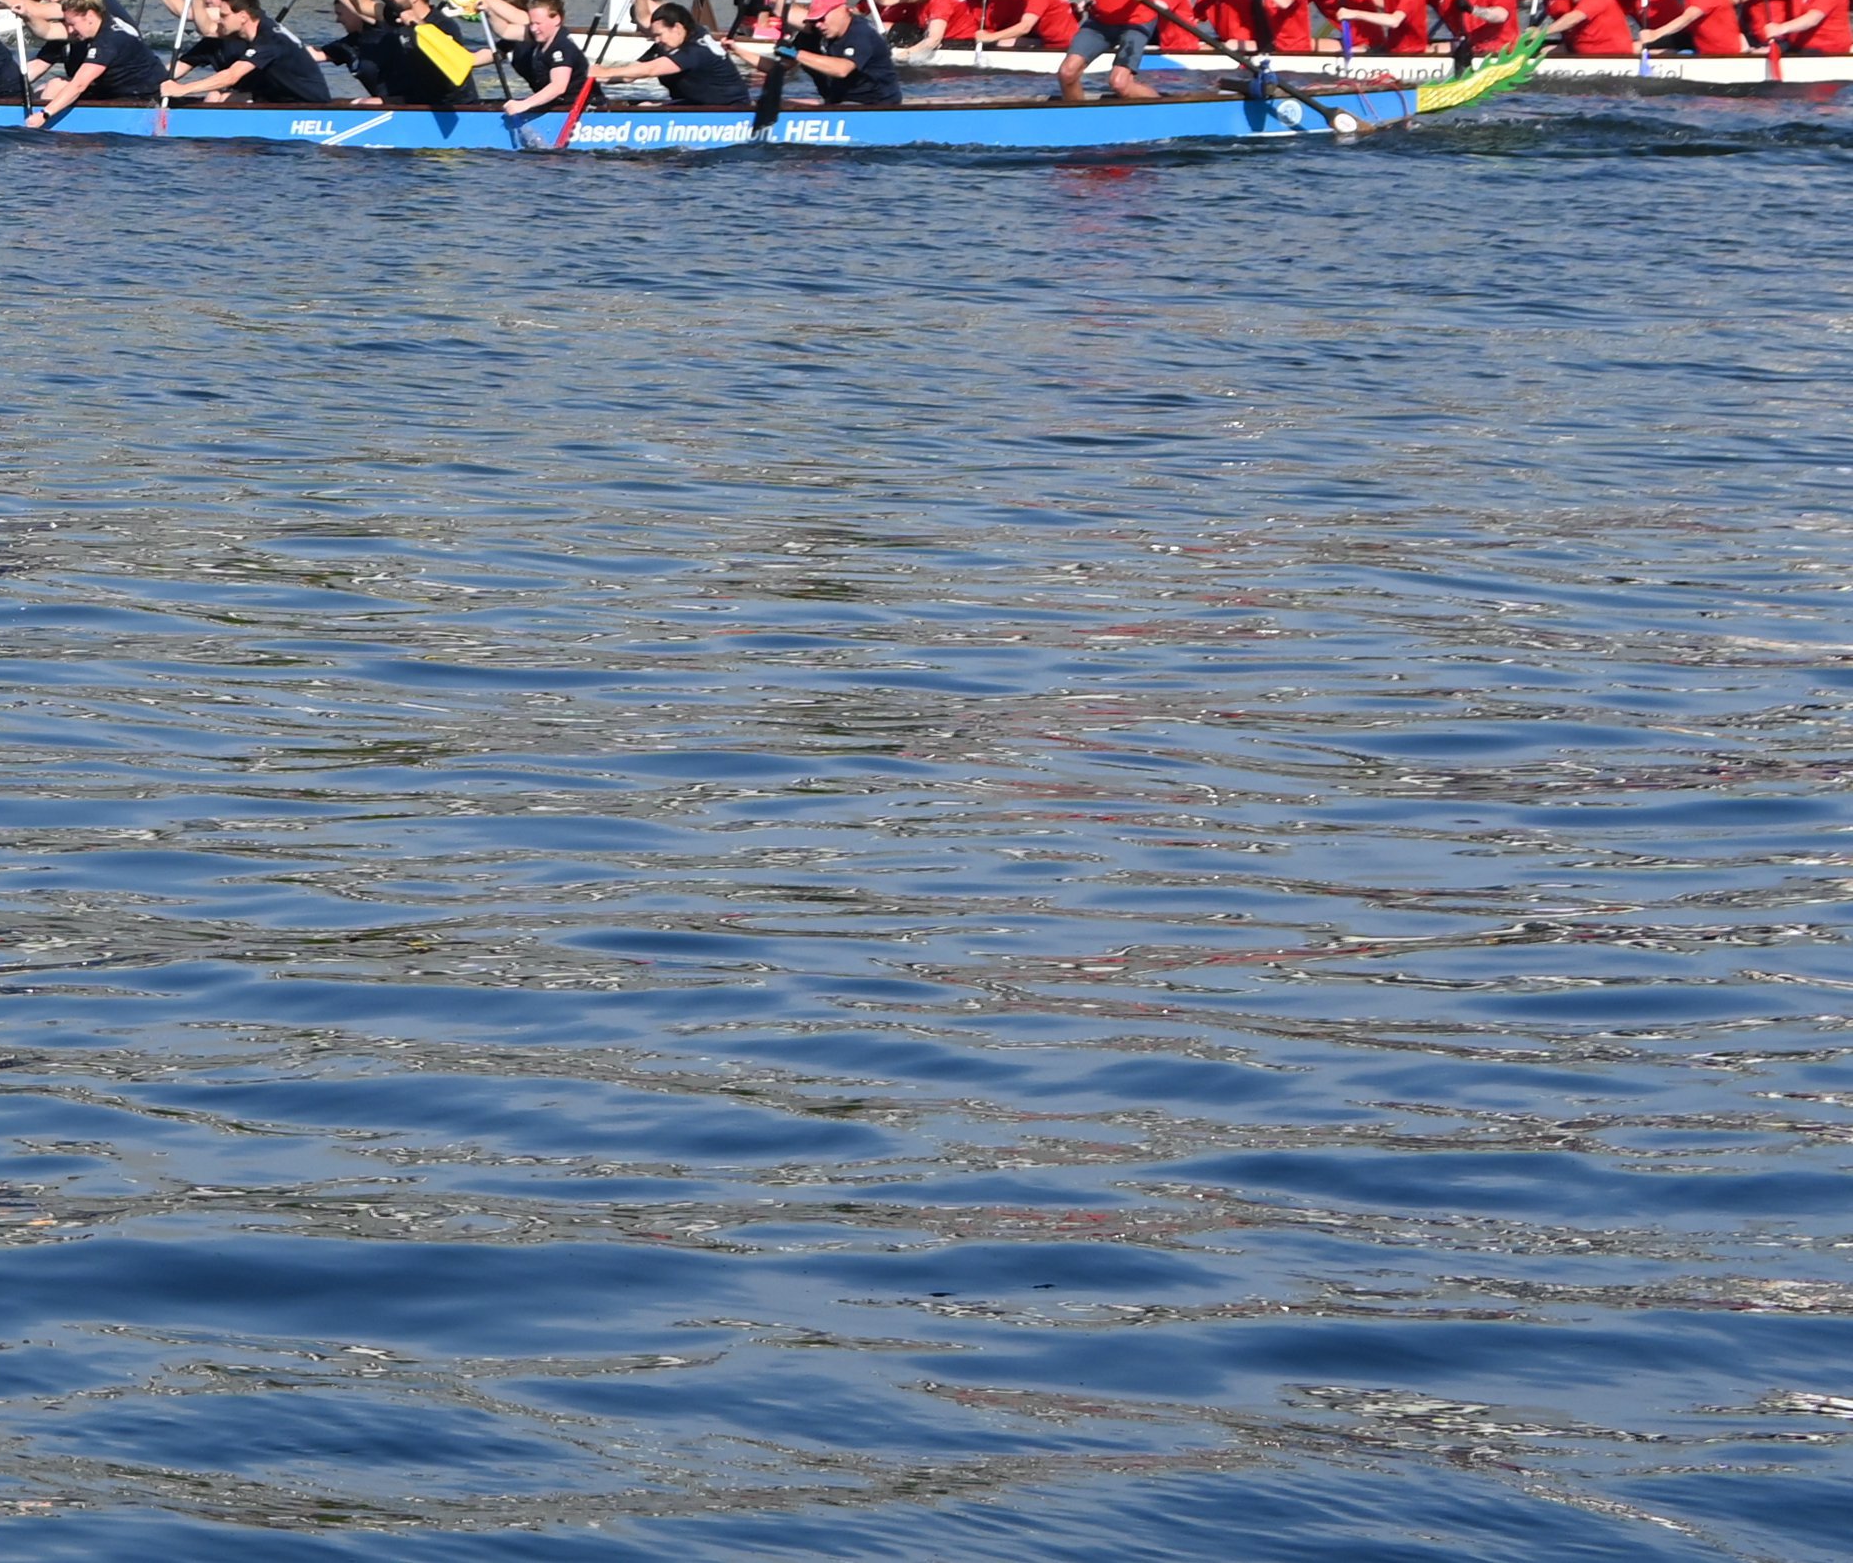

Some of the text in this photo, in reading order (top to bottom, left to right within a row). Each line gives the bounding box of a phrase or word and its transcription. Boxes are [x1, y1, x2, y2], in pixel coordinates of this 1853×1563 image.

[291, 120, 337, 136] HELL
[634, 128, 663, 143] on
[784, 119, 852, 142] HELL
